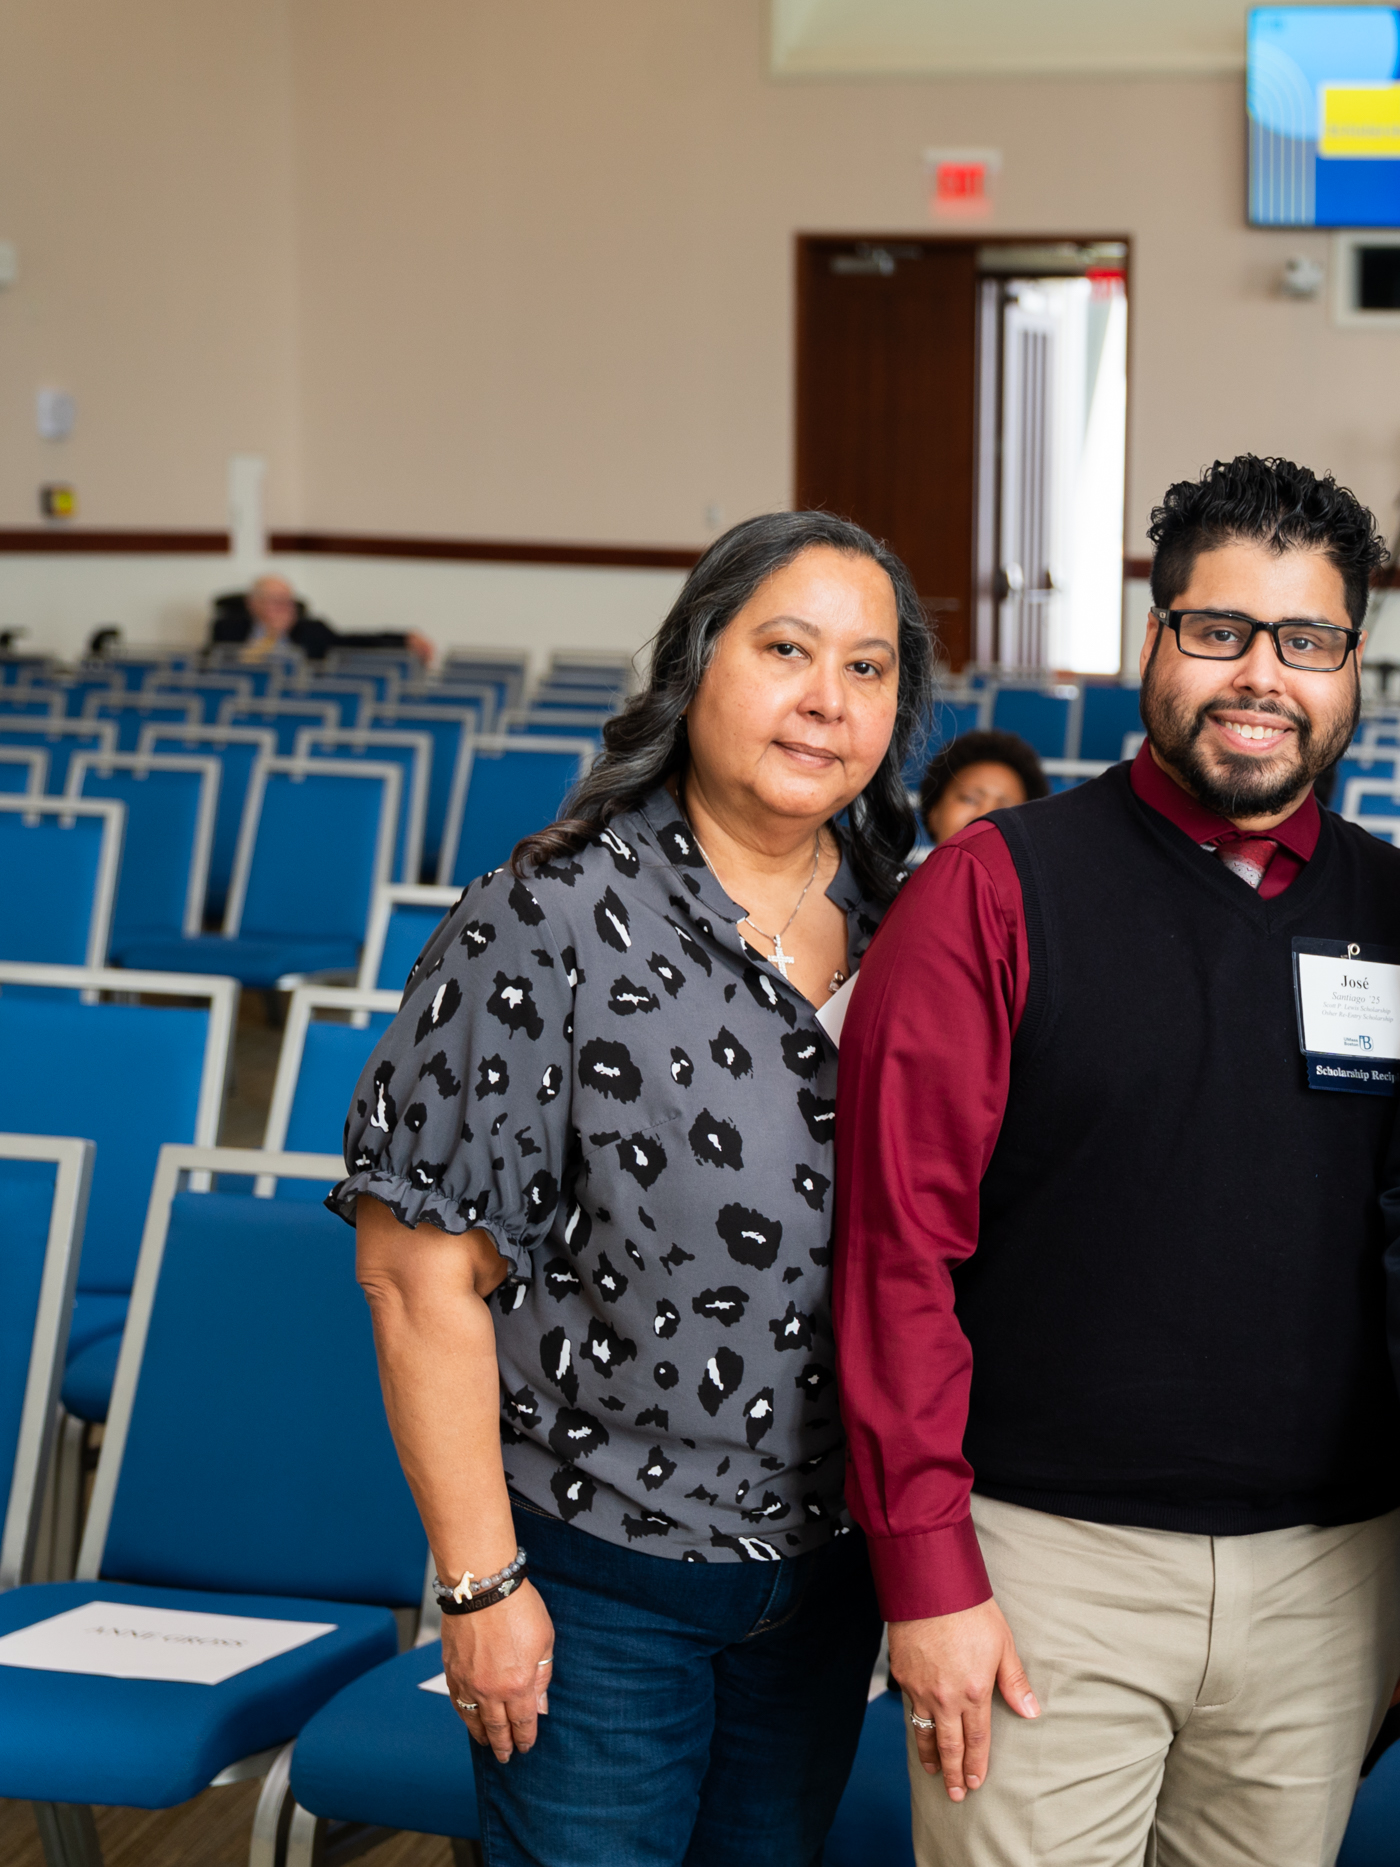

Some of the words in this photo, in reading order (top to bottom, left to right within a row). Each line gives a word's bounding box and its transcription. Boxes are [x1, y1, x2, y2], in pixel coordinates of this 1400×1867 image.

[1341, 975, 1369, 989] José
[1331, 991, 1366, 1004] Santiago
[1360, 1005, 1392, 1015] Scholarship
[1362, 1013, 1394, 1024] Scholarship
[1316, 1065, 1369, 1081] Scholarship
[464, 1591, 500, 1611] Maria
